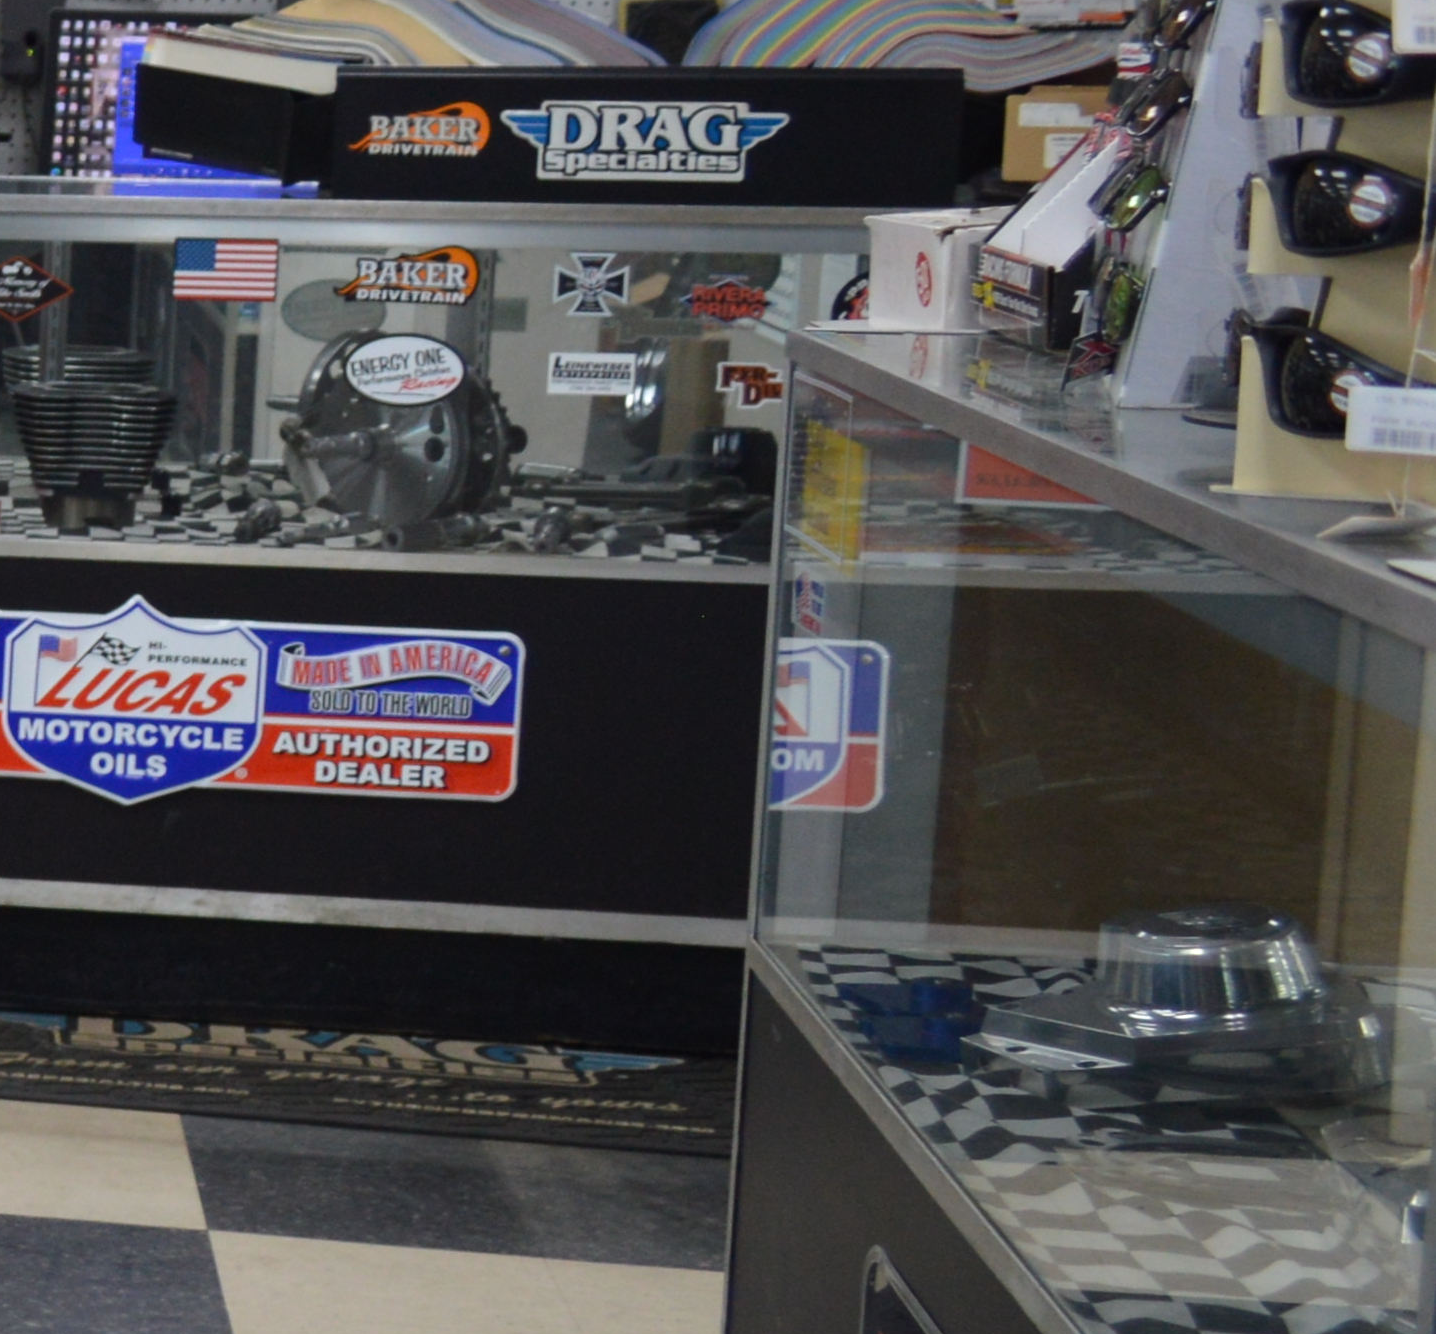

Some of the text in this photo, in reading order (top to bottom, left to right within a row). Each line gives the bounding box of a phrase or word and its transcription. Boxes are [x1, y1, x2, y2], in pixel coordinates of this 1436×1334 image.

[369, 114, 480, 142] BAKER
[547, 105, 743, 153] DRAG
[367, 142, 479, 158] DRIVETRAIN
[543, 148, 740, 176] Specialties
[358, 259, 468, 289] BAKER
[355, 288, 466, 304] DRIVETRAIN
[691, 284, 767, 302] RIVERA
[691, 302, 766, 319] PRIMO
[350, 347, 447, 377] ENERGY ONE
[399, 376, 459, 392] Racing
[147, 641, 168, 651] HI-
[147, 653, 248, 667] PERFORMANCE
[292, 644, 495, 686] MADE IN AMERICA
[35, 666, 248, 716] LUCAS
[310, 689, 472, 718] SOLD TO THE WORLD
[17, 717, 245, 751] MOTORCYCLE
[272, 730, 491, 763] AUTHORIZED
[90, 751, 168, 778] OILS
[314, 759, 447, 789] DEALER
